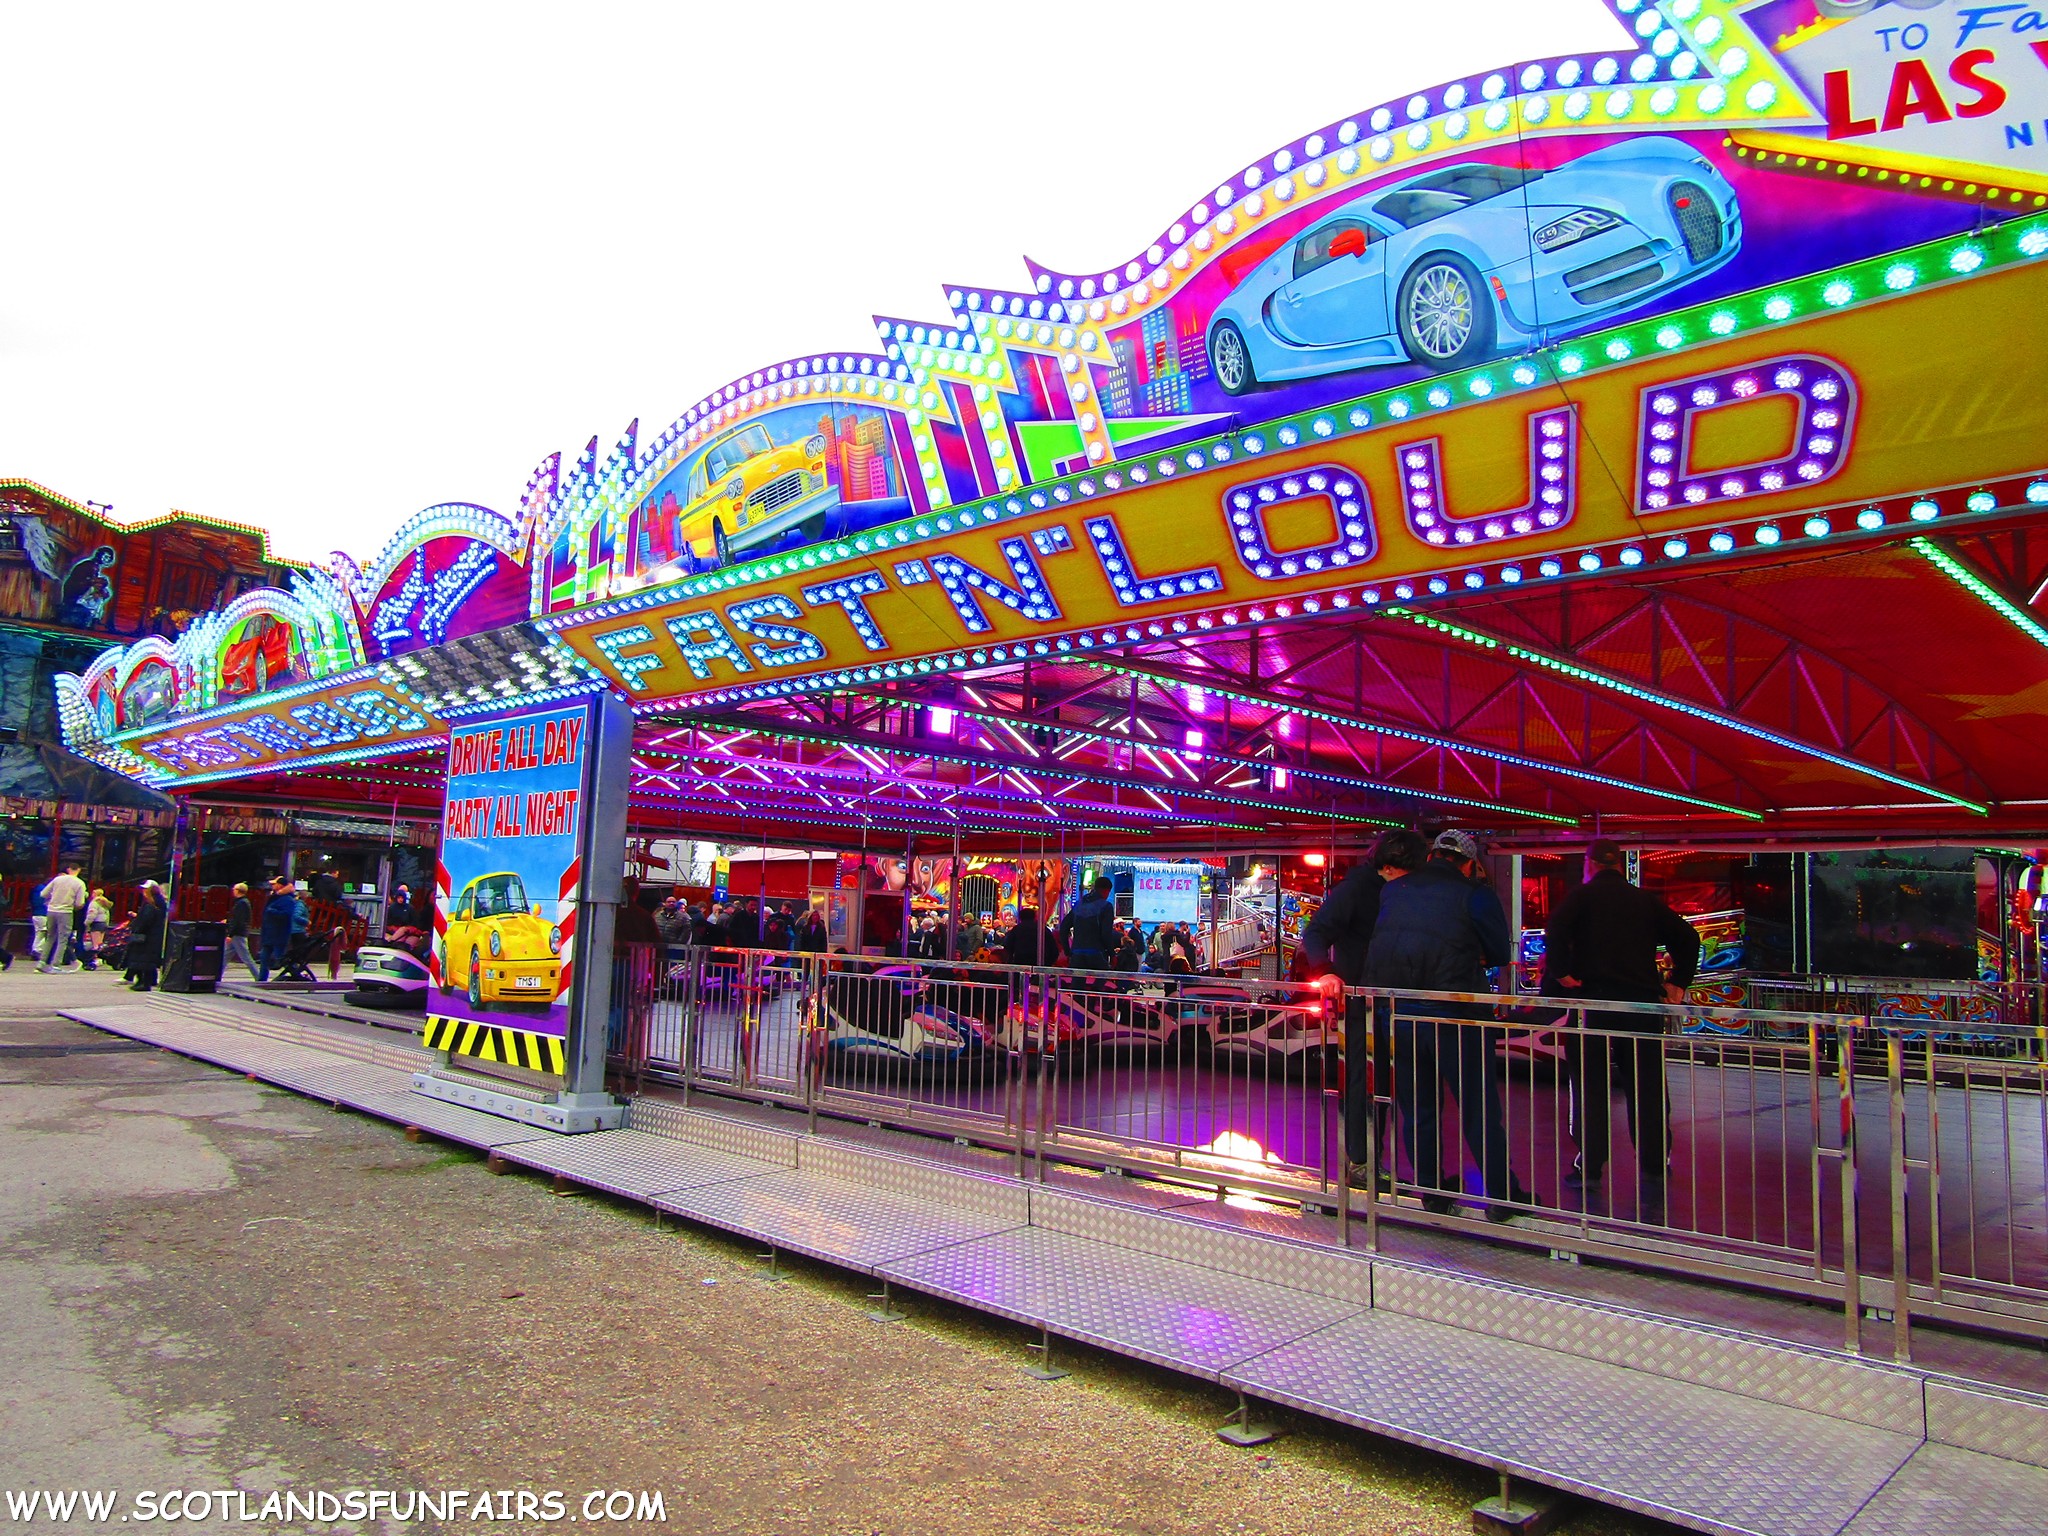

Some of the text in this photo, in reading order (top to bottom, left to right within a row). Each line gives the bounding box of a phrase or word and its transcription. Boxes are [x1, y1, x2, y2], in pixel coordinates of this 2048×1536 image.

[1874, 22, 1930, 53] TO
[1824, 47, 2008, 141] LAS
[594, 570, 891, 692] FAST
[1082, 352, 1859, 607] LOUD
[451, 716, 584, 778] DRIVE ALL DAY
[445, 788, 579, 840] PARTY ALL NIGHT
[1139, 877, 1193, 891] ICE JET
